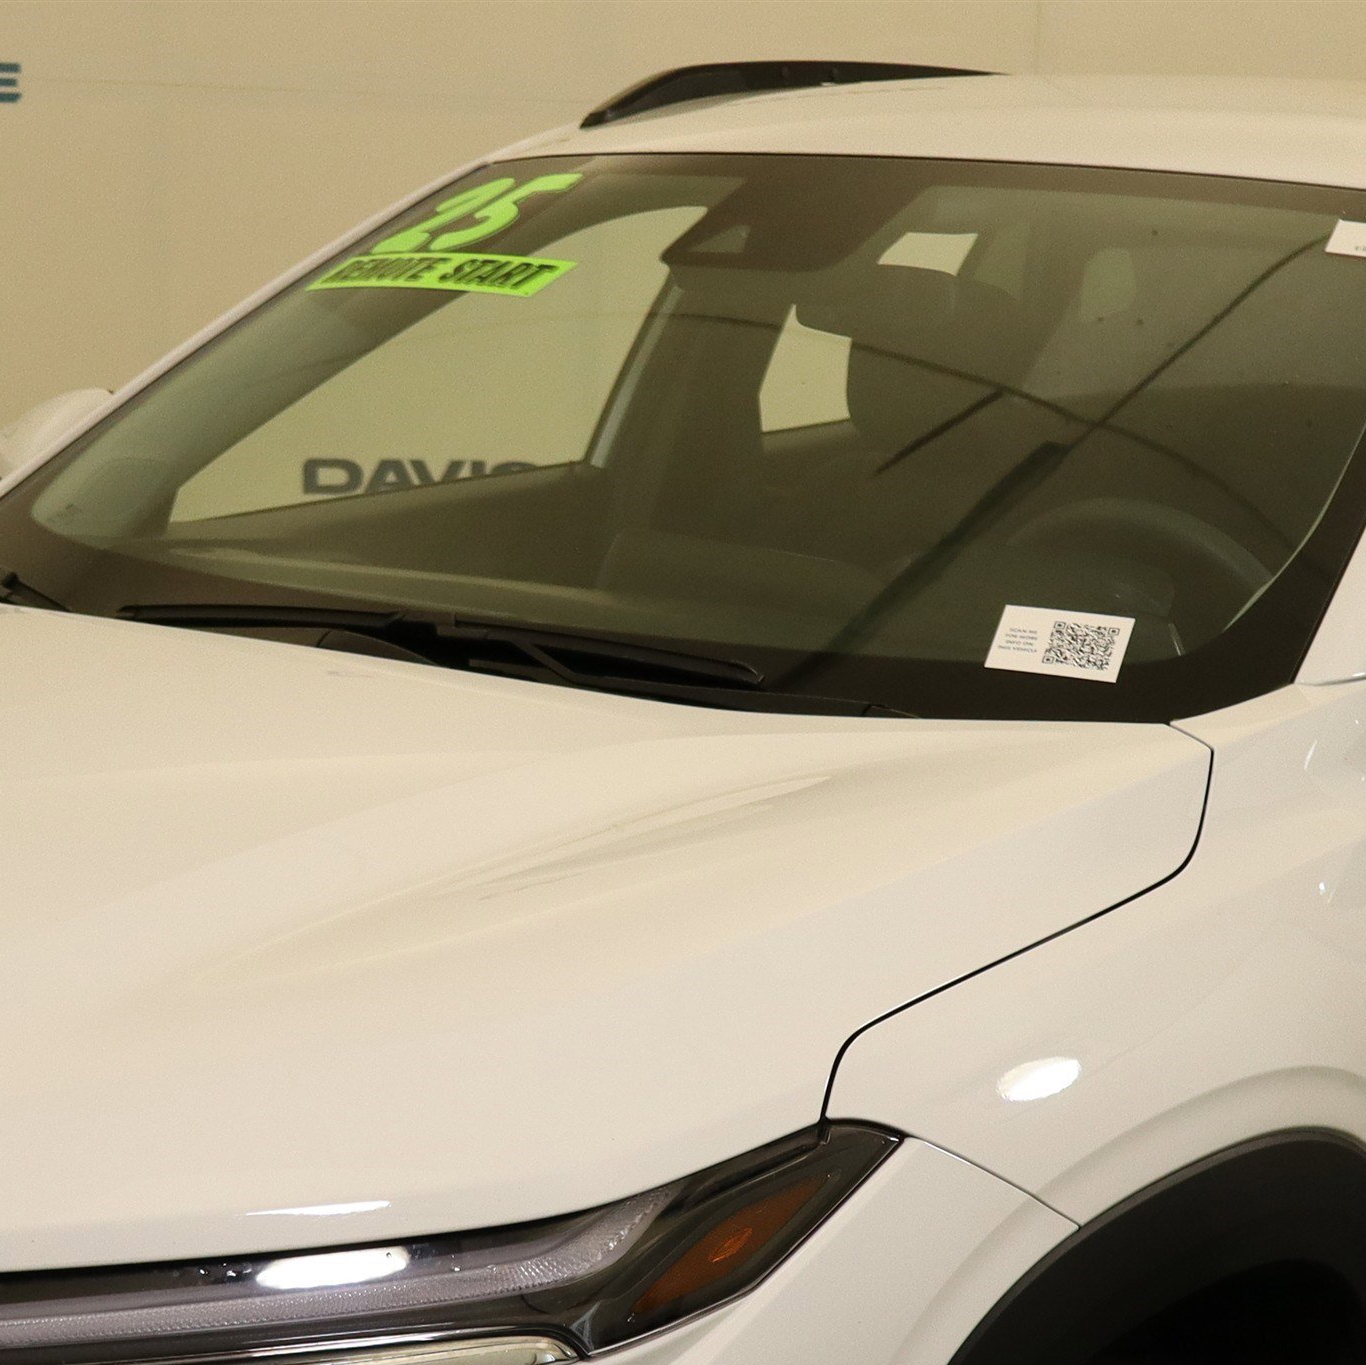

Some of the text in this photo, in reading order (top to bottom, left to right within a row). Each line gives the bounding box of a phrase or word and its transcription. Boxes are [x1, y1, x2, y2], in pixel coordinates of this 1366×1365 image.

[371, 173, 583, 254] 25
[321, 257, 559, 289] REMOTE START
[303, 457, 540, 495] DAV
